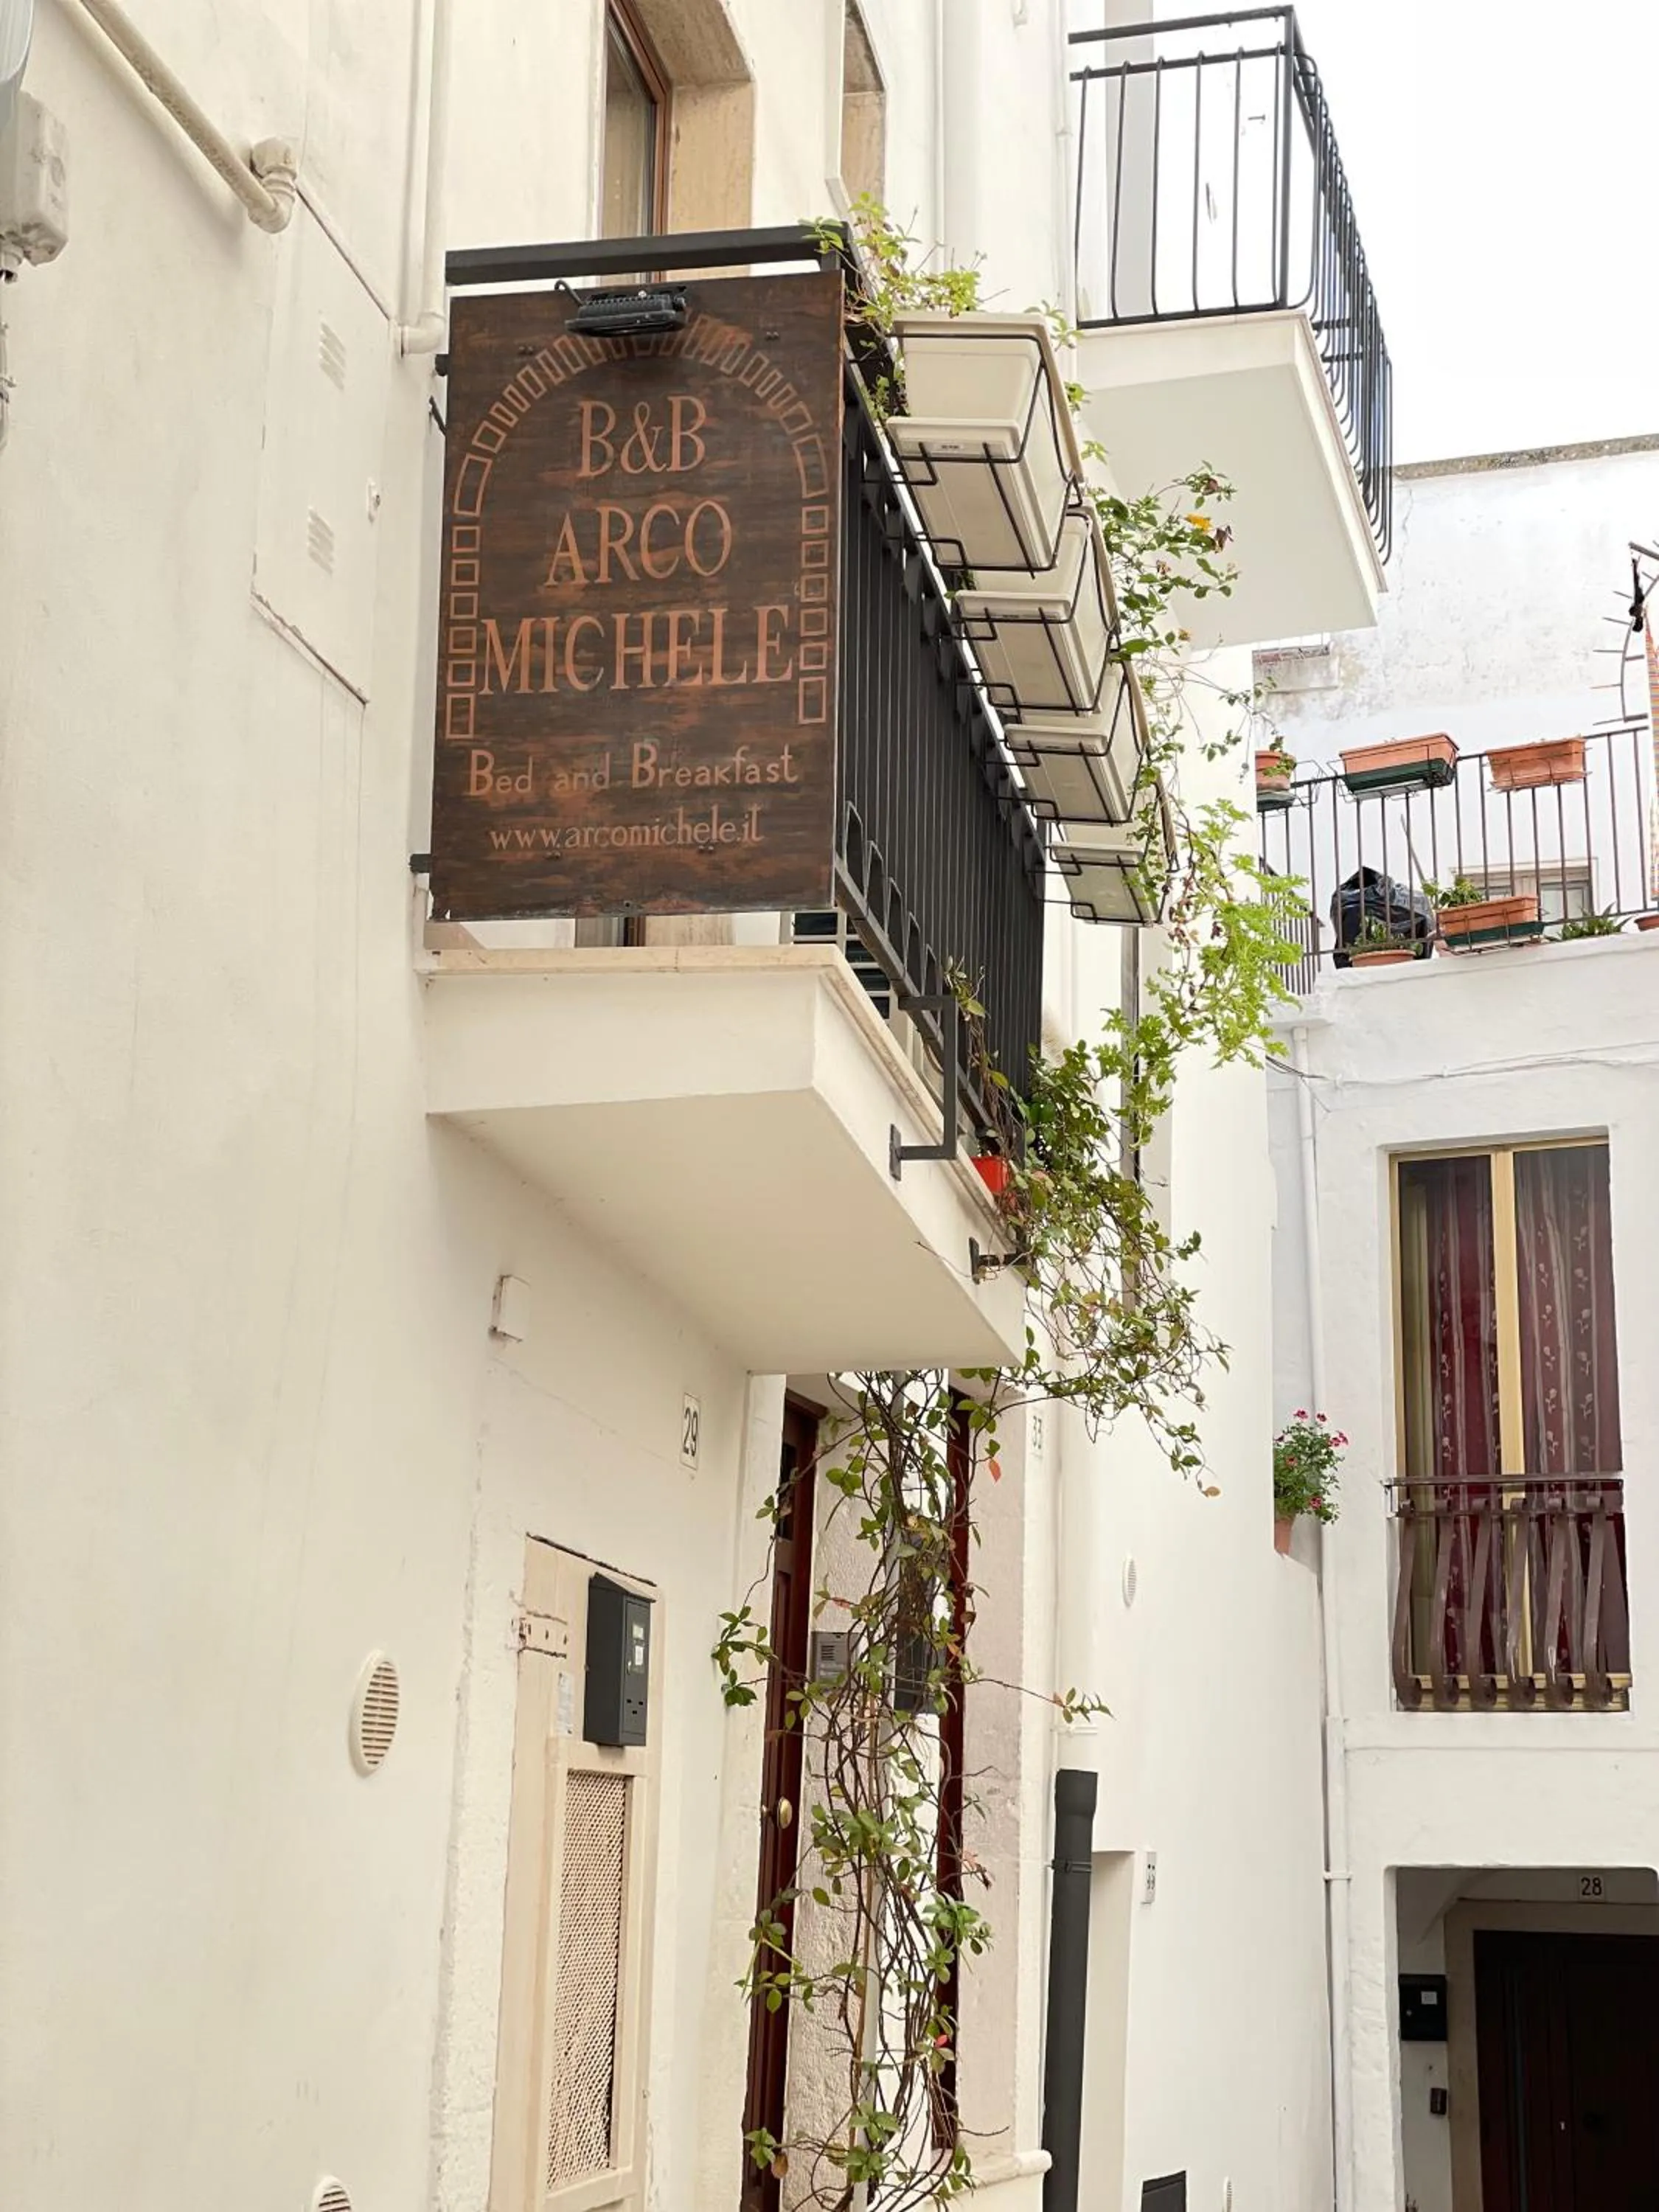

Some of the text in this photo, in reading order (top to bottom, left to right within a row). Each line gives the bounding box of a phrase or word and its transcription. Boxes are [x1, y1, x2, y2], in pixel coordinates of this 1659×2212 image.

[579, 395, 707, 479] B&B
[545, 501, 733, 587] ARCO
[478, 605, 793, 695] MICHELE
[468, 742, 799, 796] Bed and Breakfast
[490, 802, 765, 850] www.arcomichele.it
[683, 1406, 698, 1457] 29
[1581, 1877, 1602, 1896] 28
